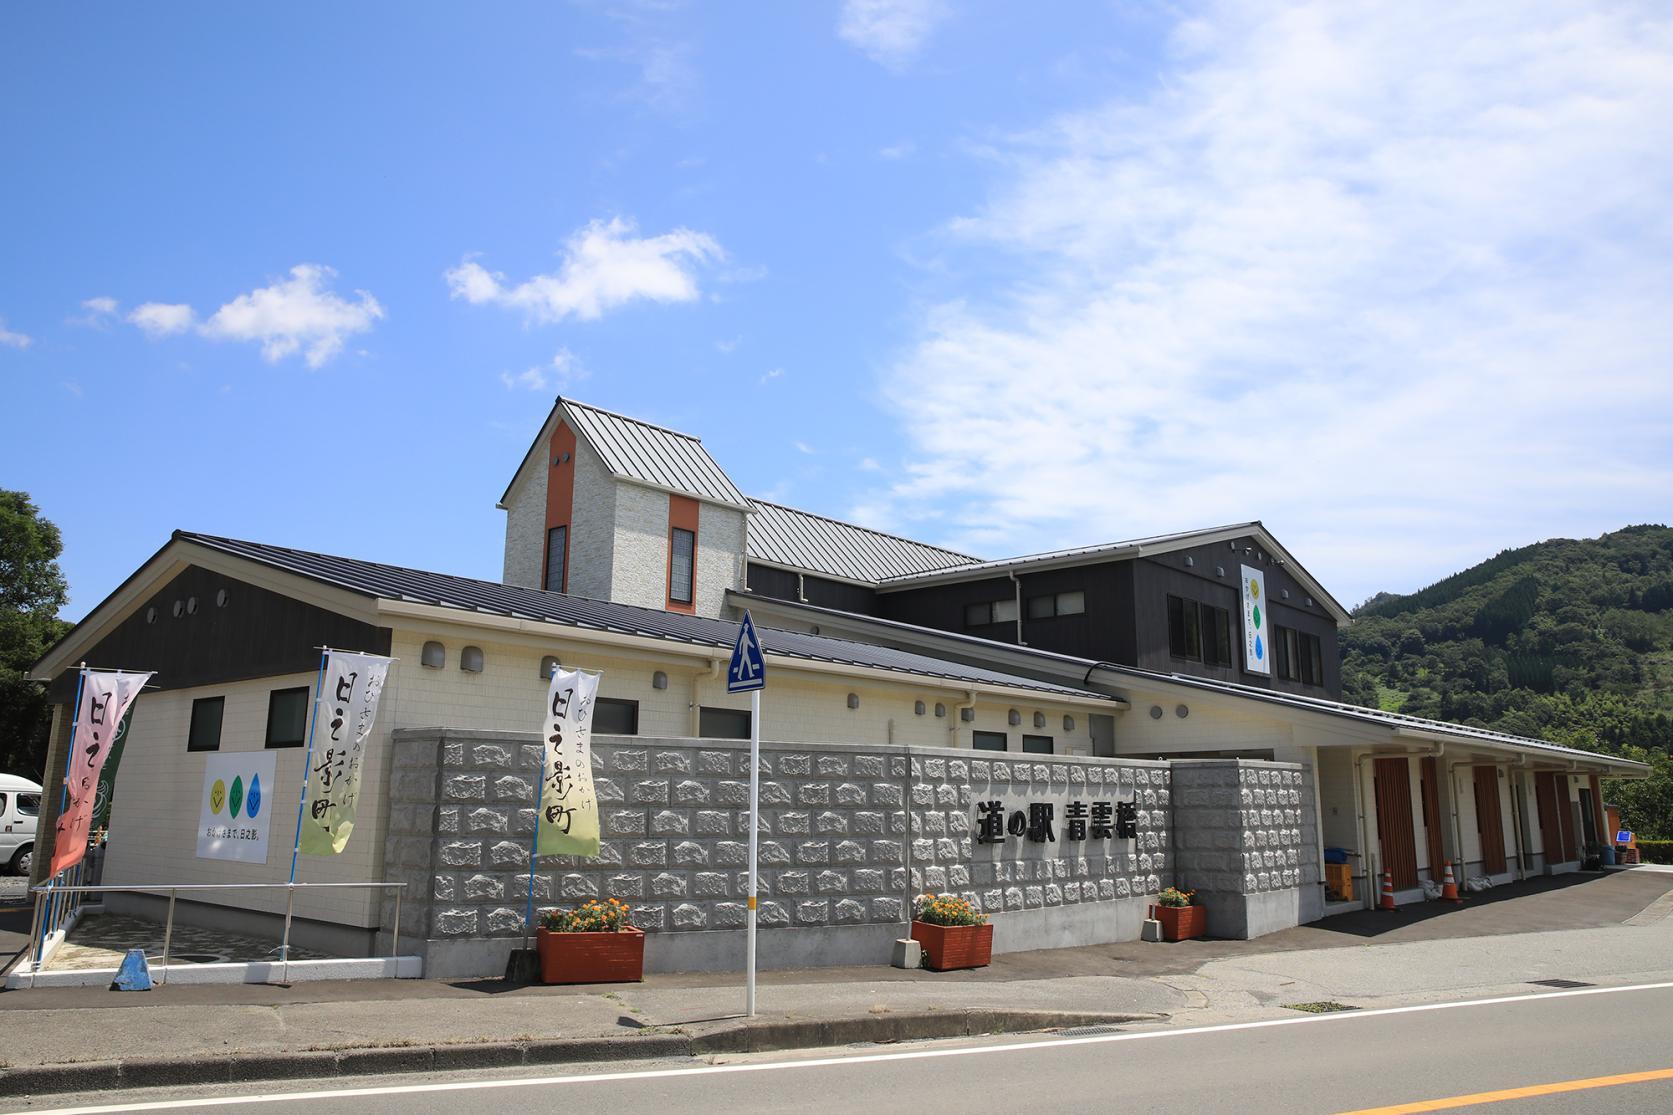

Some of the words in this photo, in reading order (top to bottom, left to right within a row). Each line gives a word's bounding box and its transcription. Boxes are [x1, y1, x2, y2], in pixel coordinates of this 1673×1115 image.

[545, 688, 577, 834] 日之影町
[977, 800, 1055, 844] 道の駅
[1065, 800, 1137, 841] 青雲橋
